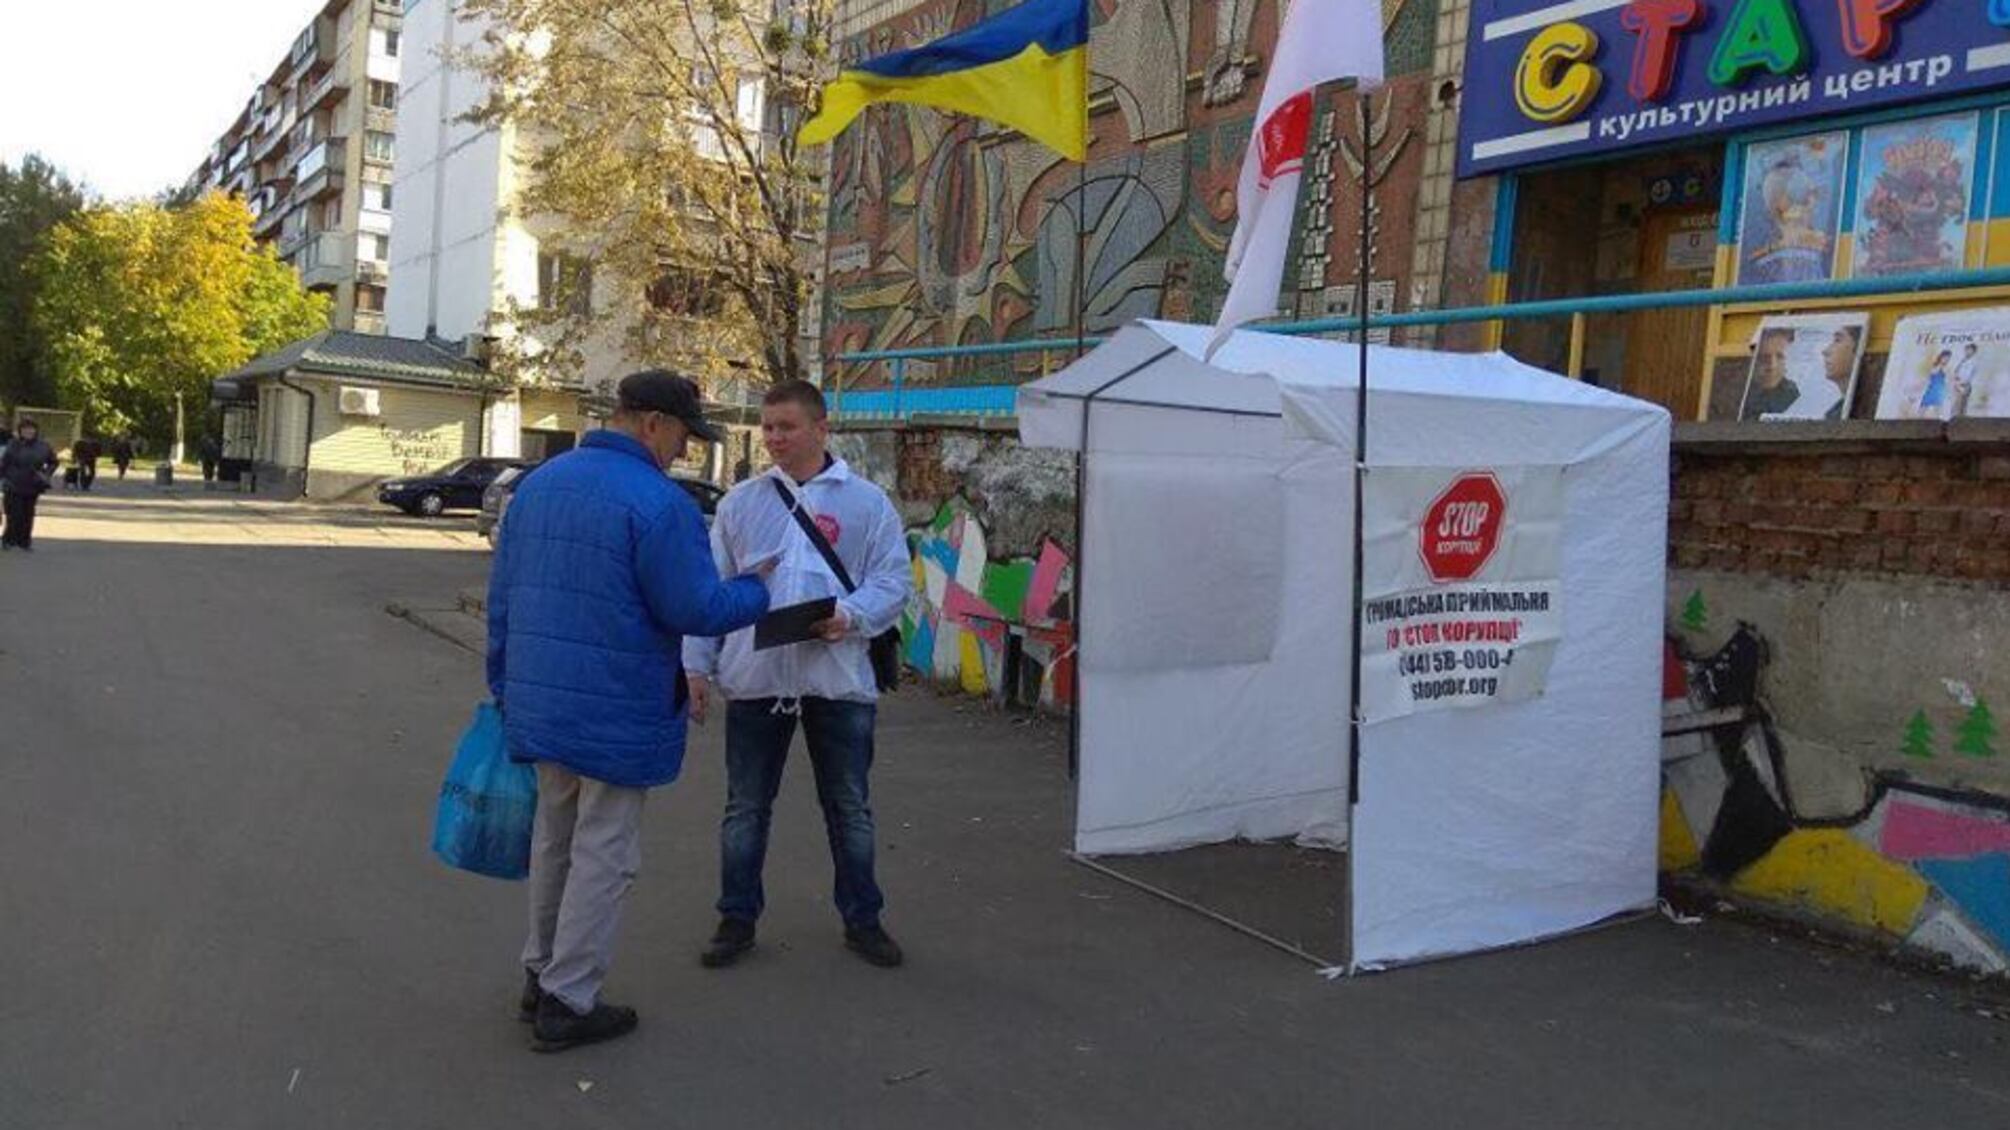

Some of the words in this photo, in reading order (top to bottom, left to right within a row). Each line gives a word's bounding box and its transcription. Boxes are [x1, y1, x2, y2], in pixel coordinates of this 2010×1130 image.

[1515, 0, 2010, 123] СТАР
[1600, 77, 1810, 140] культурний
[1824, 54, 1953, 100] центр
[1439, 501, 1489, 537] STOP
